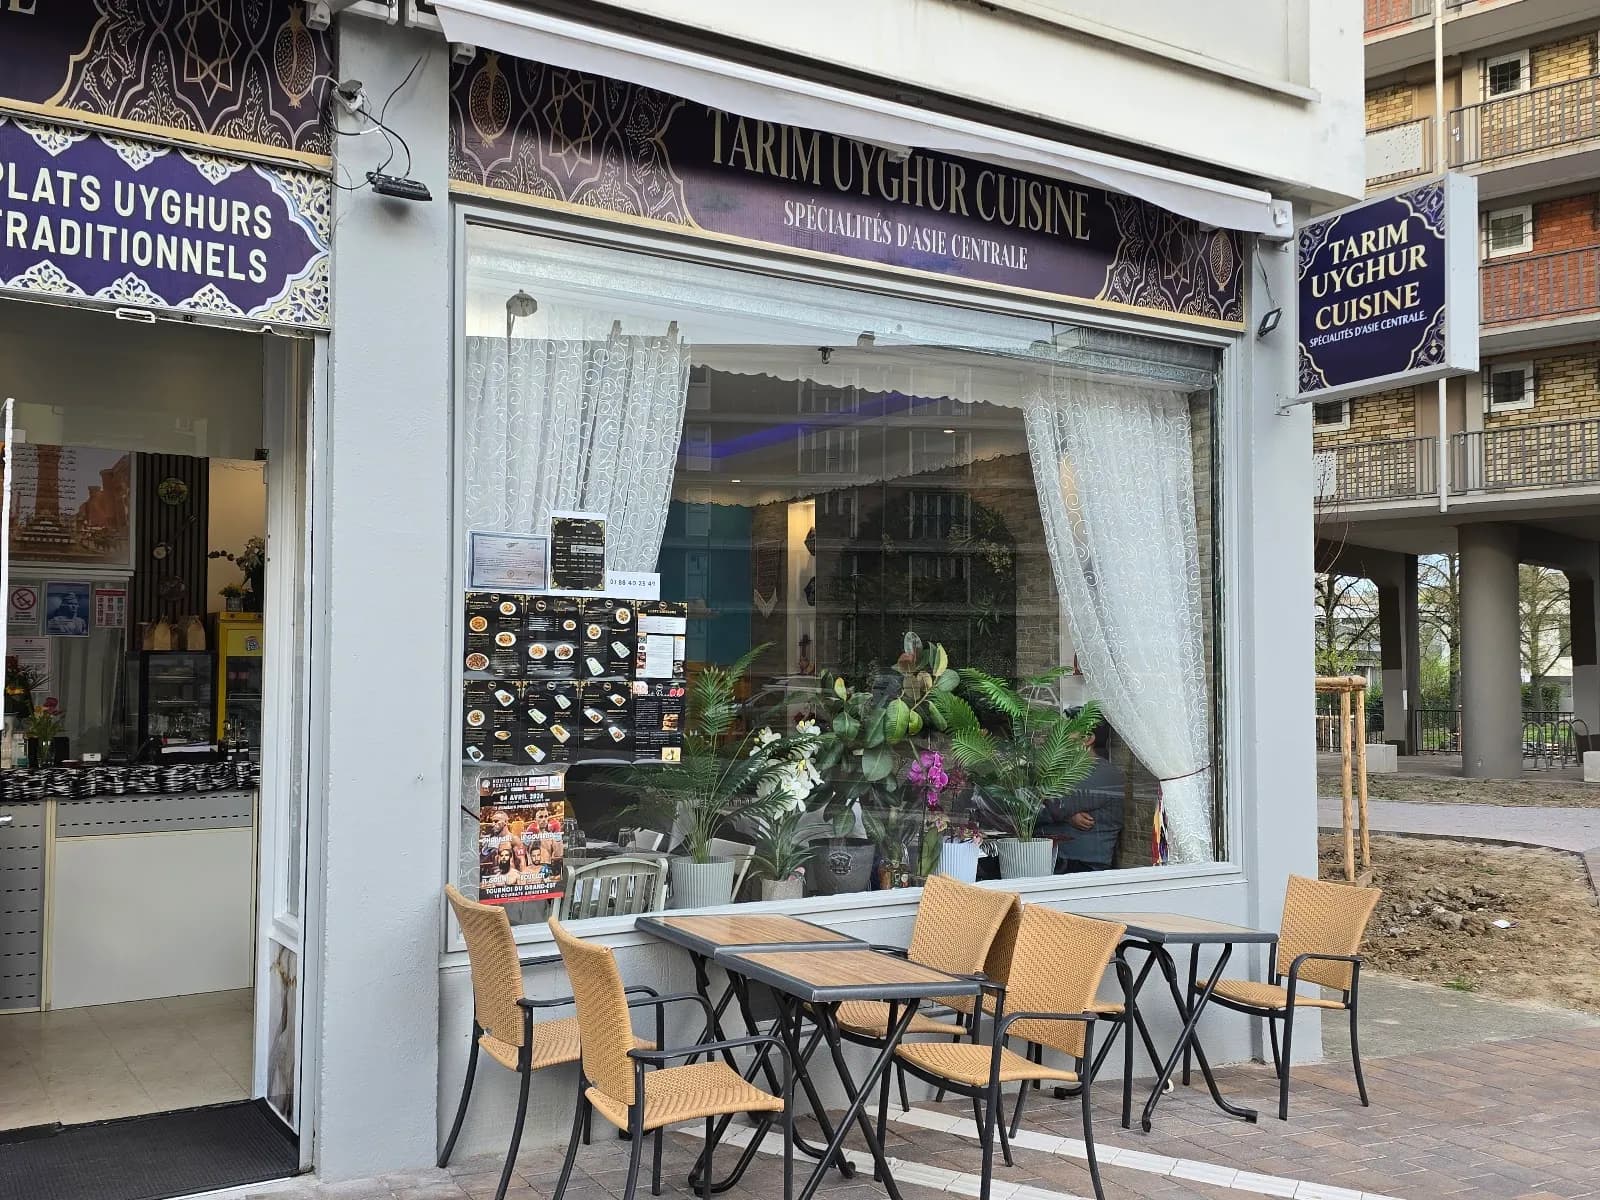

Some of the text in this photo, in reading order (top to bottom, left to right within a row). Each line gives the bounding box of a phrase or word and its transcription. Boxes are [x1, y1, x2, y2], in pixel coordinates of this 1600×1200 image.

[706, 105, 1091, 241] TARIM UYGHUR CUISINE
[0, 162, 272, 240] LATS UYGHURS
[0, 208, 267, 284] RADITIONNELS
[783, 199, 1028, 270] SPÉCIALITÉS D'ASIE CENTRALE
[1329, 218, 1409, 265] TARIM
[1311, 243, 1428, 298] UYGHUR
[1315, 281, 1421, 330] CUISINE
[1309, 326, 1354, 348] SPÉCIALITÉS
[1354, 322, 1379, 337] D'ASIE
[486, 886, 513, 895] TOURNOI
